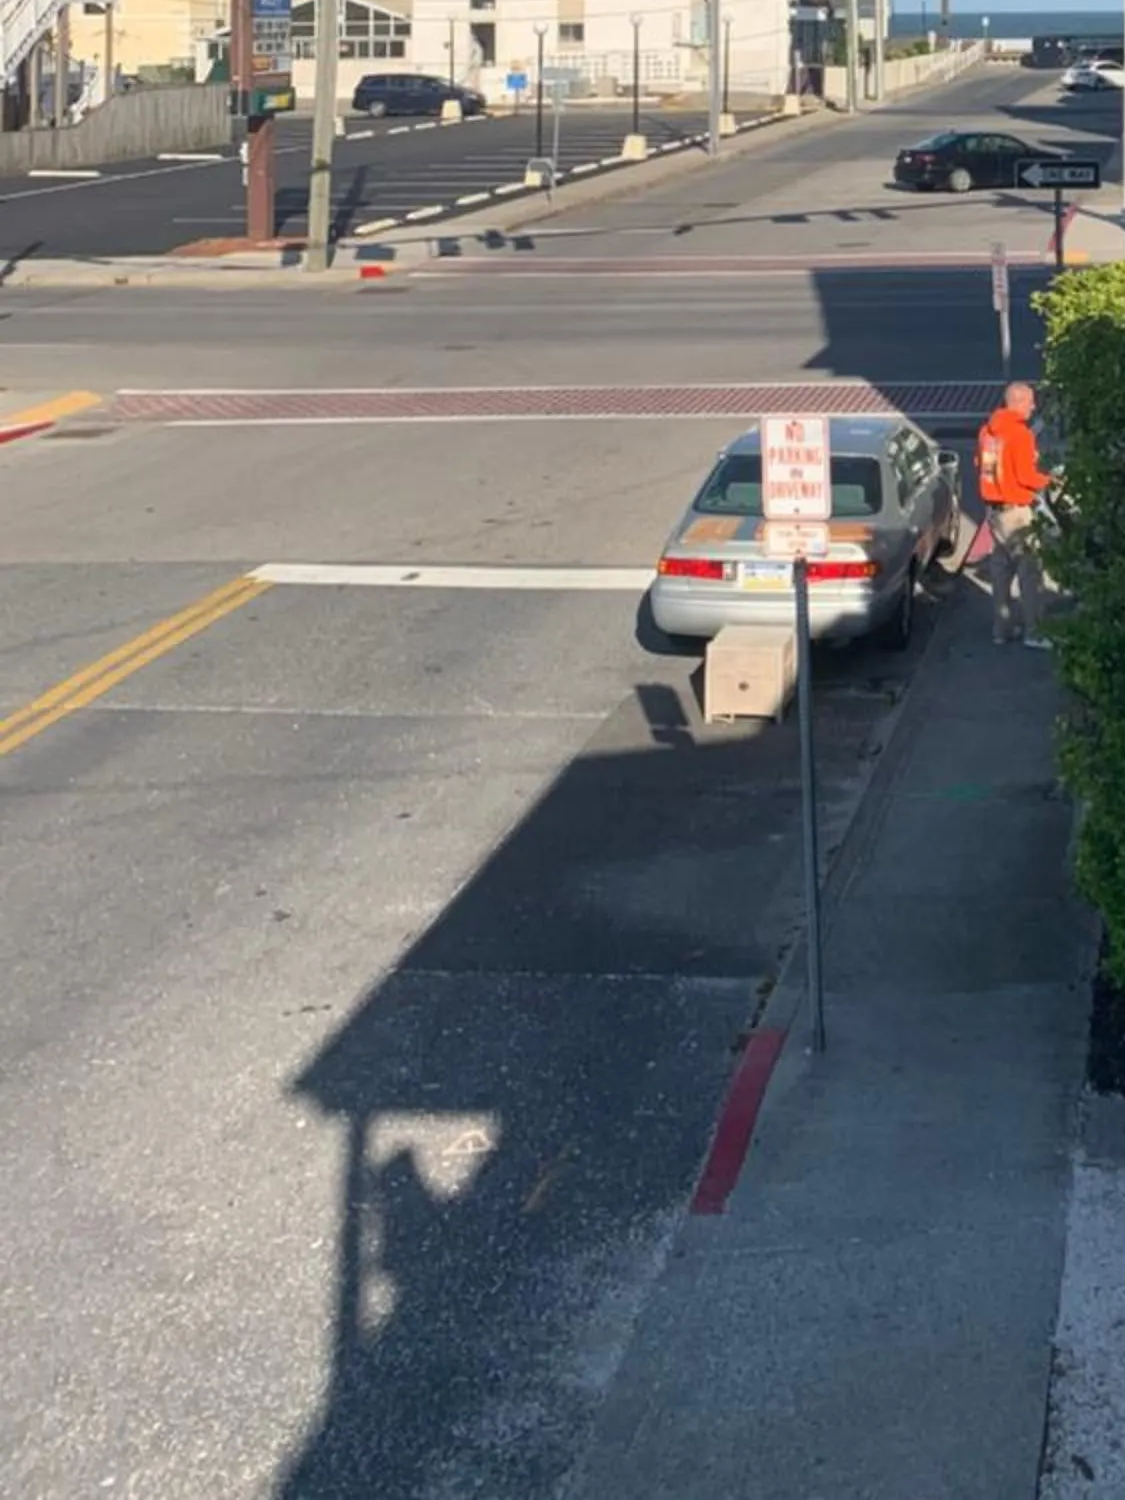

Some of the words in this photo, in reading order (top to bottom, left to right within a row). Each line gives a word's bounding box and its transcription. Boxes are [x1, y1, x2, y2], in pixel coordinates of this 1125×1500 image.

[785, 423, 805, 443] NO
[769, 447, 822, 465] PARKING
[769, 481, 823, 498] DRIVEWAY
